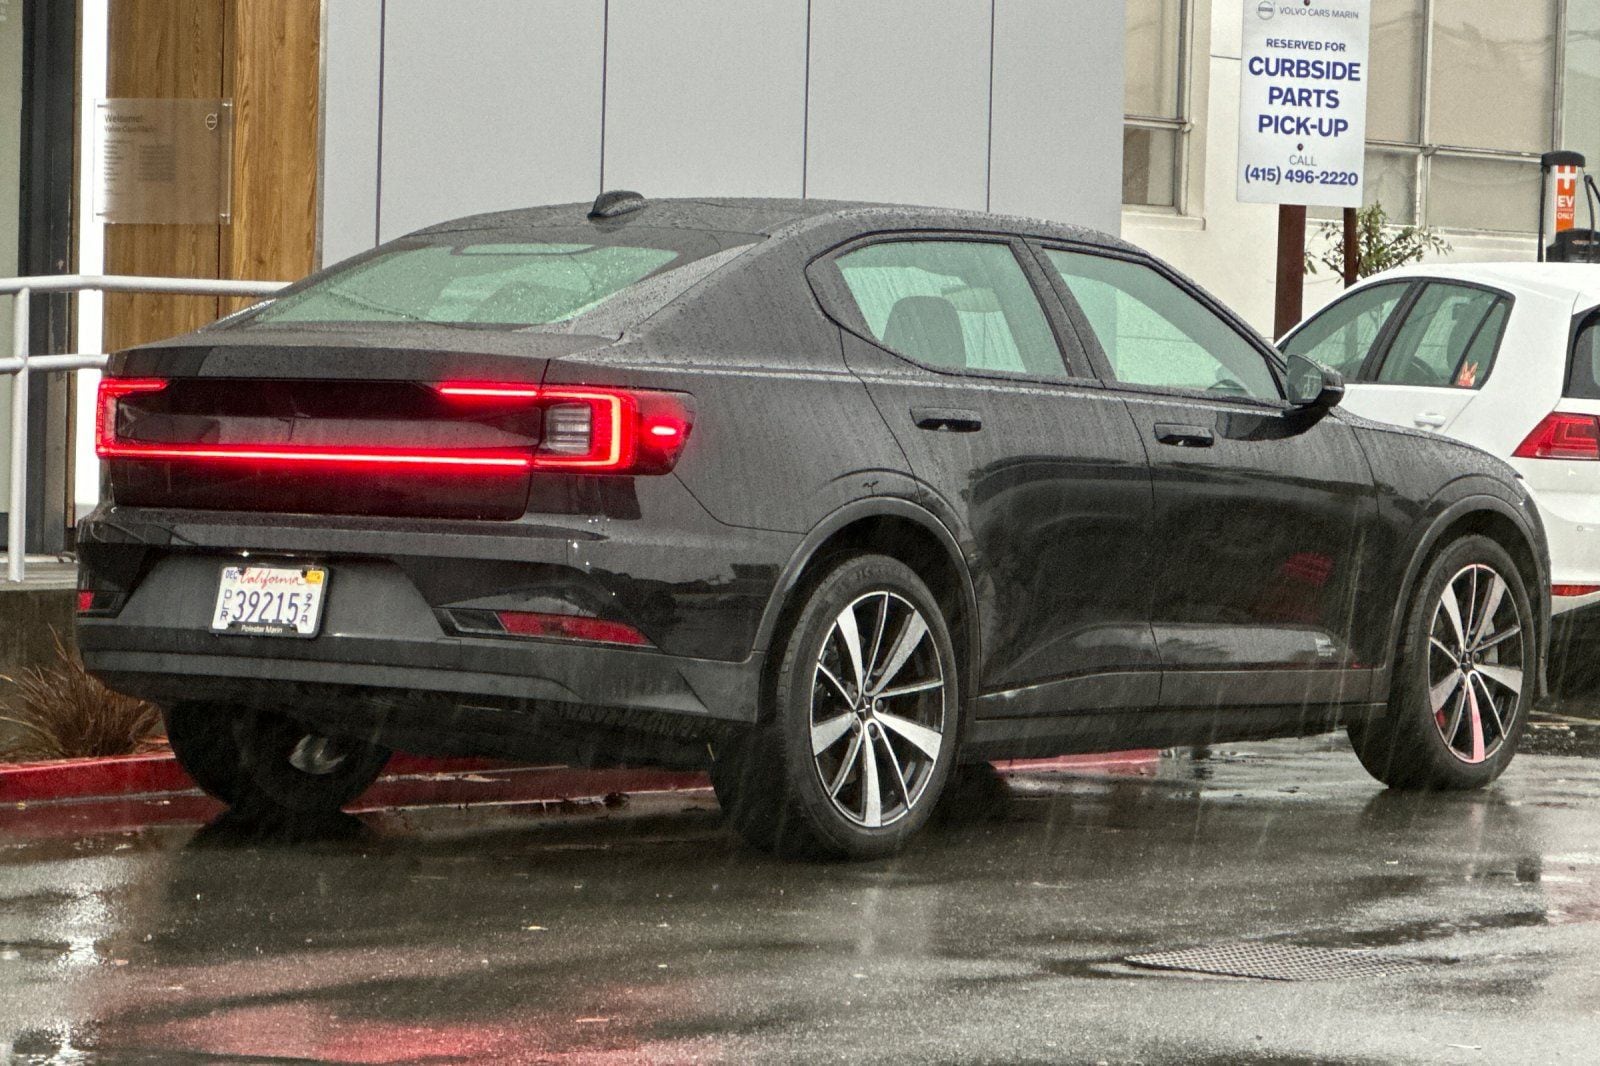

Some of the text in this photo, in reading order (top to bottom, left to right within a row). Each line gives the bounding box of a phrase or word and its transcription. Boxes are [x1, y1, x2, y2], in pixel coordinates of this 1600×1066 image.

[1279, 6, 1307, 16] VOLVO
[1308, 8, 1331, 18] CARS
[1332, 10, 1359, 19] MARIN
[1266, 38, 1346, 52] RESERVED FOR
[1248, 56, 1361, 82] CURBSIDE
[1268, 86, 1340, 109] PARTS
[1258, 114, 1349, 138] PICK-UP
[1289, 154, 1317, 167] CALL
[1245, 164, 1359, 186] (415) 496-2220
[1557, 195, 1574, 207] EV
[1557, 212, 1574, 220] ONLY
[225, 569, 238, 580] DEC
[240, 567, 305, 590] California
[232, 590, 300, 624] 39215
